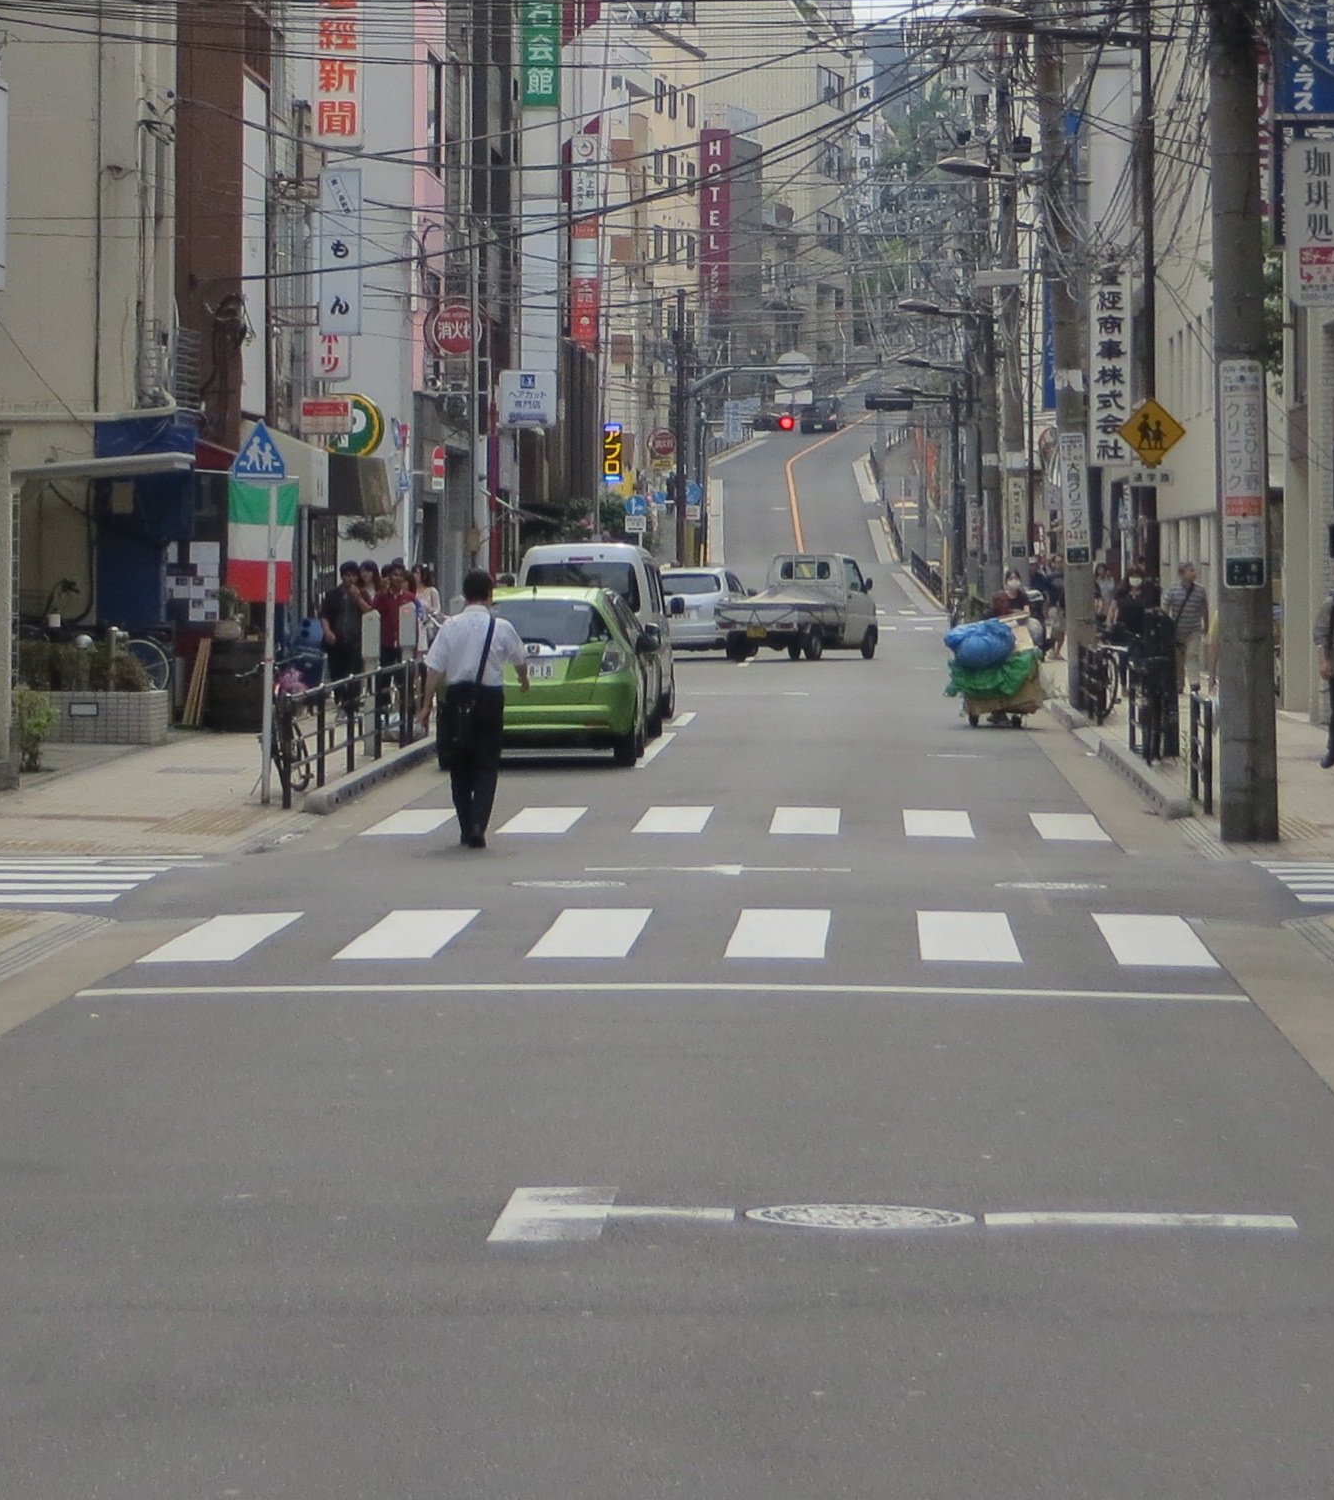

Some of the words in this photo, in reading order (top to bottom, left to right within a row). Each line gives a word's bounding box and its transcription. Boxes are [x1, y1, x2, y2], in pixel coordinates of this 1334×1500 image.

[707, 140, 723, 252] HOTEL
[1303, 146, 1334, 243] 珈琲処
[1225, 401, 1242, 491] クリニック
